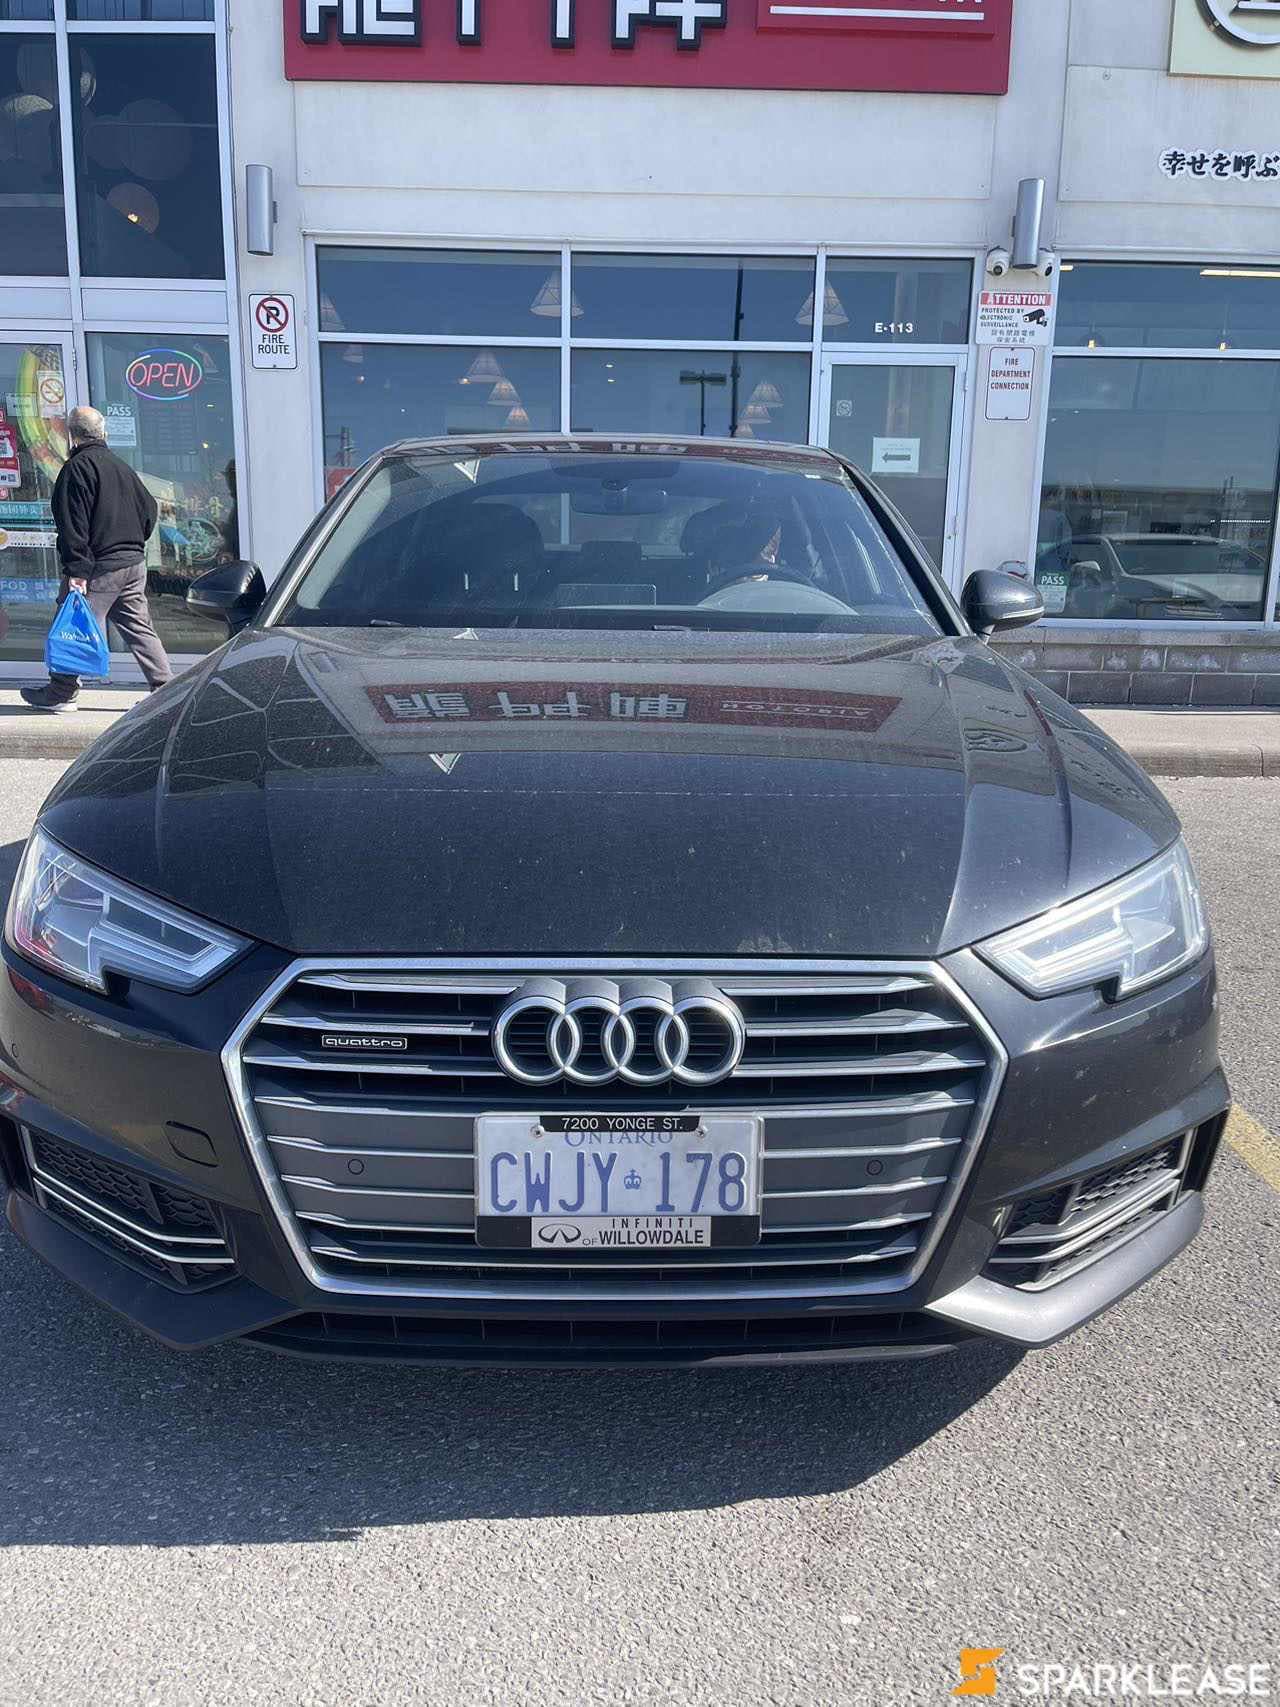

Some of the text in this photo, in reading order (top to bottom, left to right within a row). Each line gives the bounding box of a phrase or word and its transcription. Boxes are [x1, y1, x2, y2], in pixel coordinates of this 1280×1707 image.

[1162, 150, 1280, 178] 幸せを呼ぶ
[987, 294, 1046, 305] ATTENTION
[874, 322, 913, 333] E-113
[262, 333, 285, 344] FIRE
[258, 344, 290, 354] ROUTE
[1004, 358, 1019, 366] FIRE
[130, 362, 194, 387] OPEN
[991, 369, 1031, 378] DEPARTMENT
[990, 382, 1029, 390] CONNECTION
[106, 405, 132, 416] PASS
[1040, 575, 1065, 586] PASS
[325, 1037, 403, 1048] quattro
[561, 1117, 683, 1130] 7200 YONGE ST.
[564, 1131, 673, 1148] ONTARIO
[490, 1151, 746, 1213] CWJY 178
[611, 1218, 694, 1229] INFINITI
[582, 1230, 704, 1246] OF WILLOWDALE
